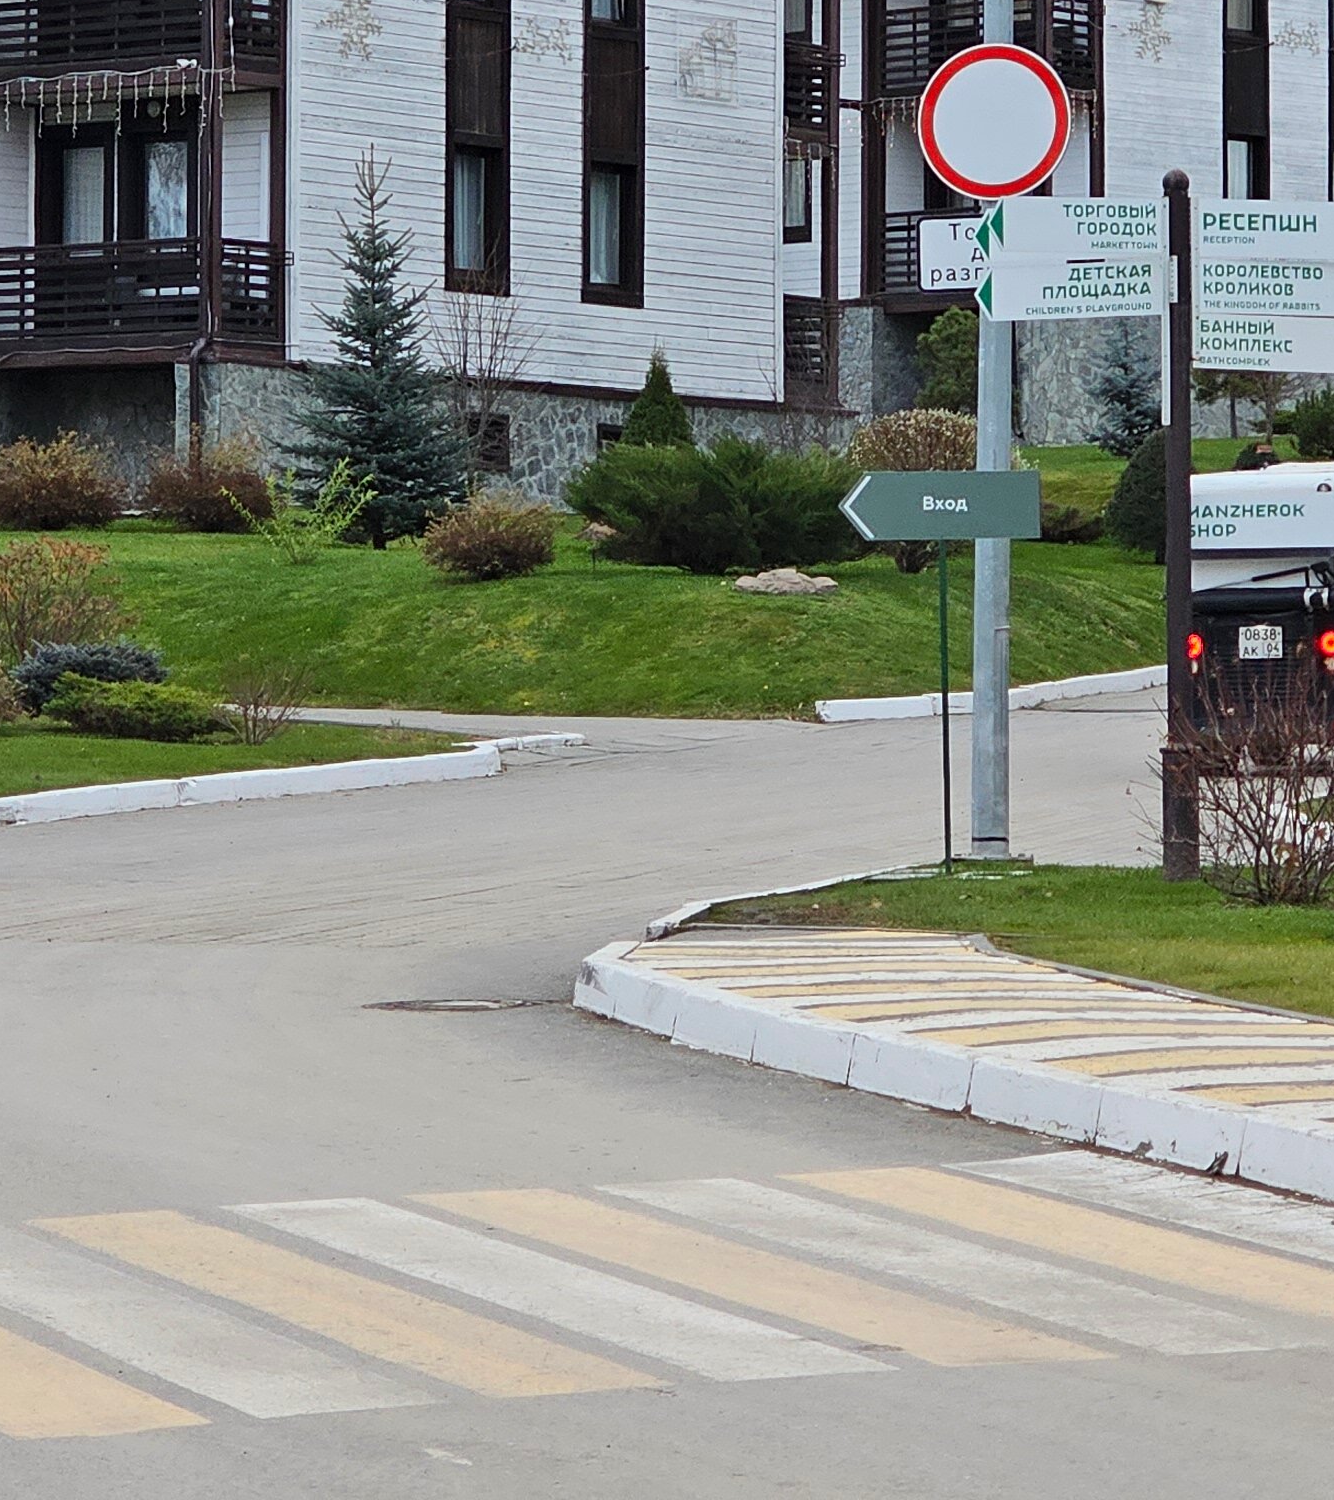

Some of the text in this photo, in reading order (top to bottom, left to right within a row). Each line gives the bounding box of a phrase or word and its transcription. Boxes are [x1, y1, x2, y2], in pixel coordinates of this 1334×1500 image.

[1062, 203, 1157, 219] ТОРГОВЫЙ
[1076, 222, 1157, 236] ГОРОДОК
[1203, 213, 1317, 233] РЕСЕПШН
[1203, 236, 1256, 244] RECEPTION
[1068, 264, 1152, 283] ДЕТСКАЯ
[1203, 264, 1324, 280] КОРОЛЕВСТВО
[1042, 282, 1152, 300] ПЛОЩАДКА
[1203, 282, 1294, 296] КРОЛИКОВ
[1085, 302, 1153, 313] PLAYGROUND
[1204, 300, 1321, 311] THE KINGDOM OF RABBITS
[1200, 319, 1275, 335] БАННЫЙ
[1200, 337, 1293, 353] КОМПЛЕКС
[922, 495, 968, 512] Вход
